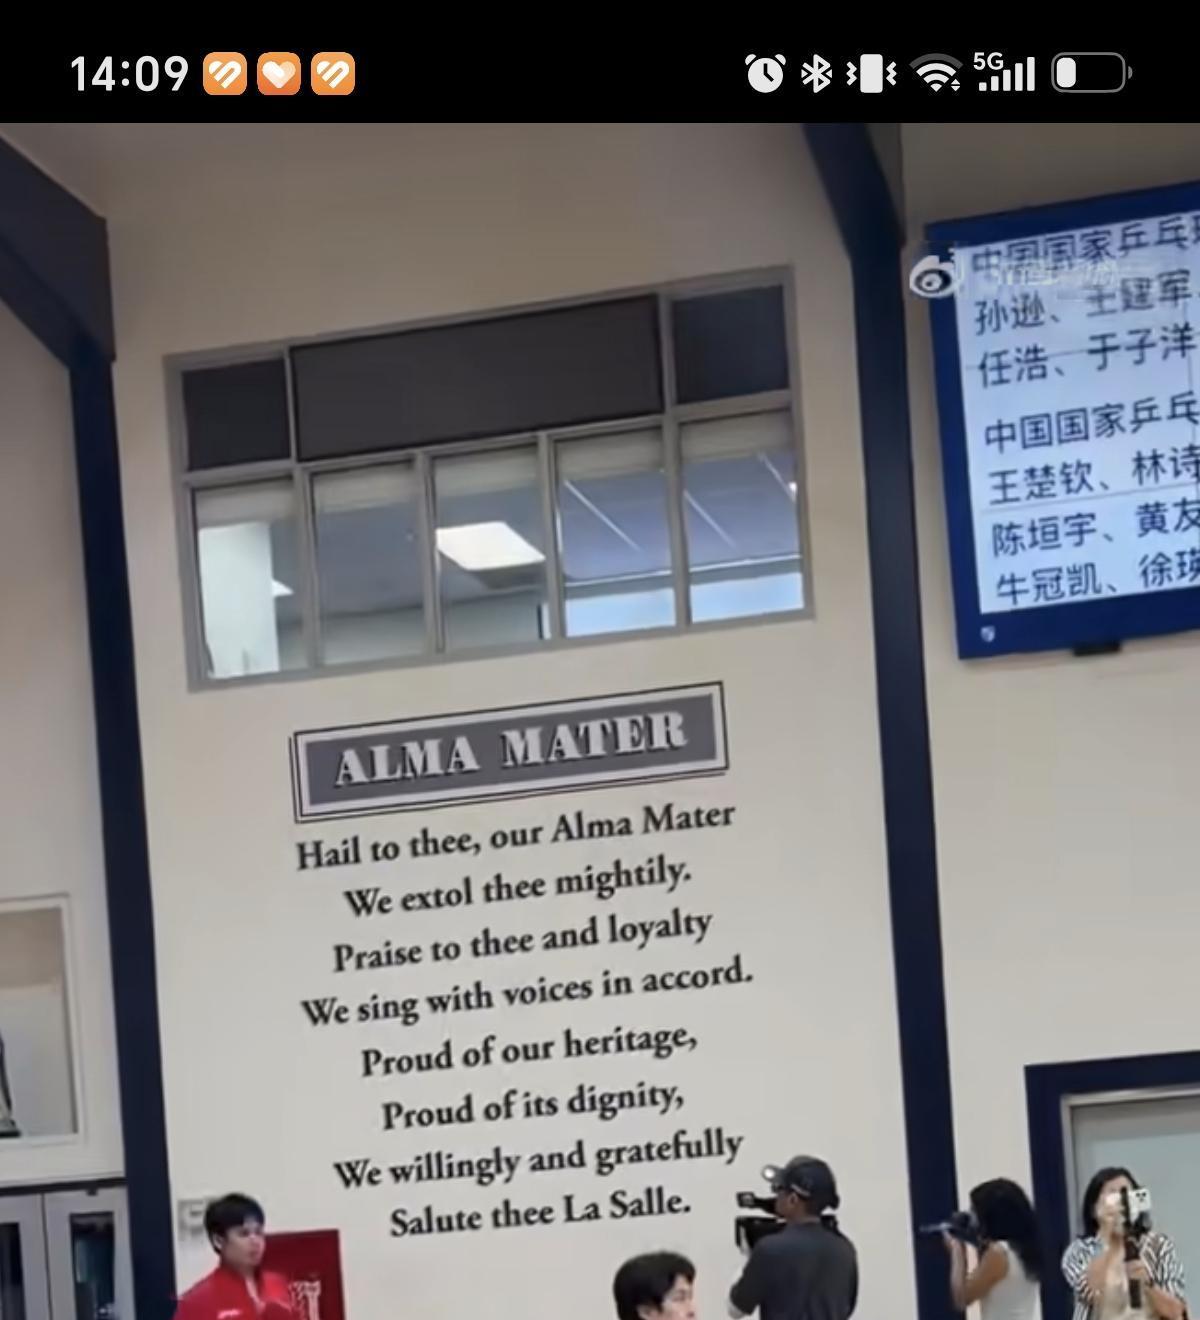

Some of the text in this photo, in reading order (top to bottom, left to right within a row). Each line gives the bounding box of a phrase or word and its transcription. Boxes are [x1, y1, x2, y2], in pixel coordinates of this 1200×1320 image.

[971, 215, 1200, 272] 中国国家乒乓
[334, 711, 689, 788] ALMA MATER
[296, 802, 736, 871] Hail to thee, our Alma Mater
[343, 853, 692, 917] We extol thee mightily.
[333, 907, 713, 973] Praise to thee and loyalty
[300, 953, 753, 1027] We sing with voices in accord.
[361, 1026, 698, 1077] Proud of our heritage,
[382, 1081, 684, 1130] Proud of its dignity,
[333, 1127, 744, 1189] We willingly and gratefully
[390, 1185, 691, 1237] Salute thee La Salle.
